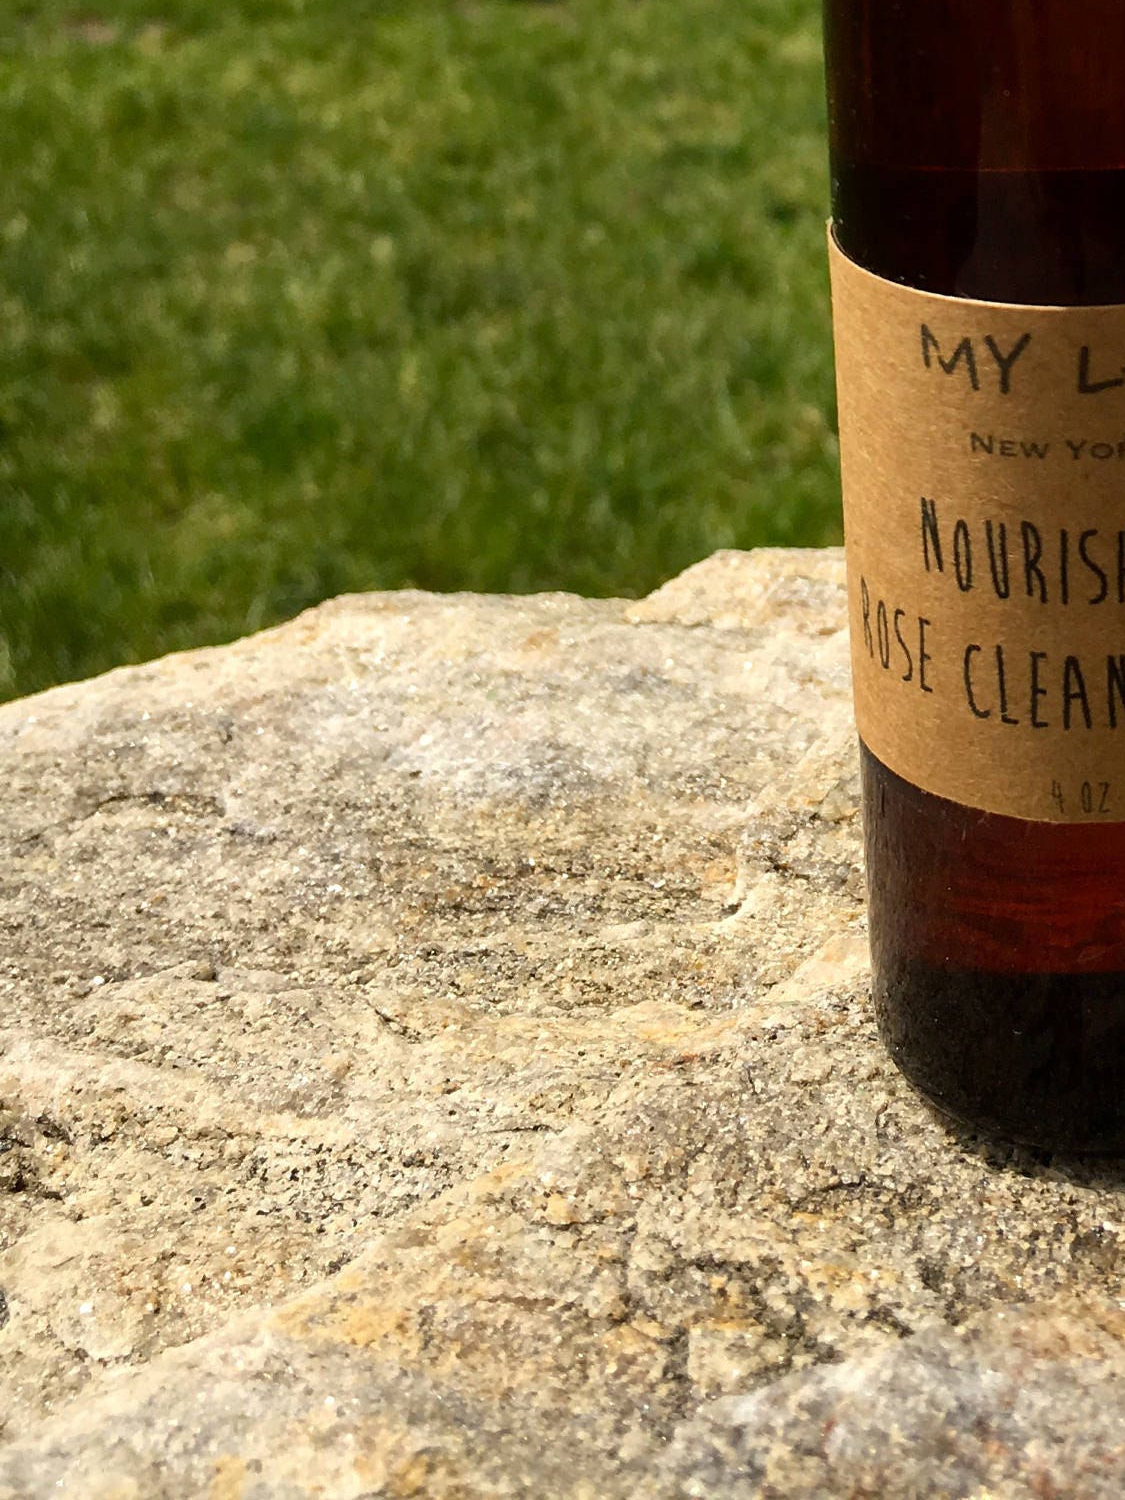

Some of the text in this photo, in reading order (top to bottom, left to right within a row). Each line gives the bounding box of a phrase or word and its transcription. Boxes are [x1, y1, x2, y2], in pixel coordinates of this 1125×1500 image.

[920, 323, 1033, 395] MY
[969, 430, 1050, 459] NEW
[860, 576, 933, 693] ROSE
